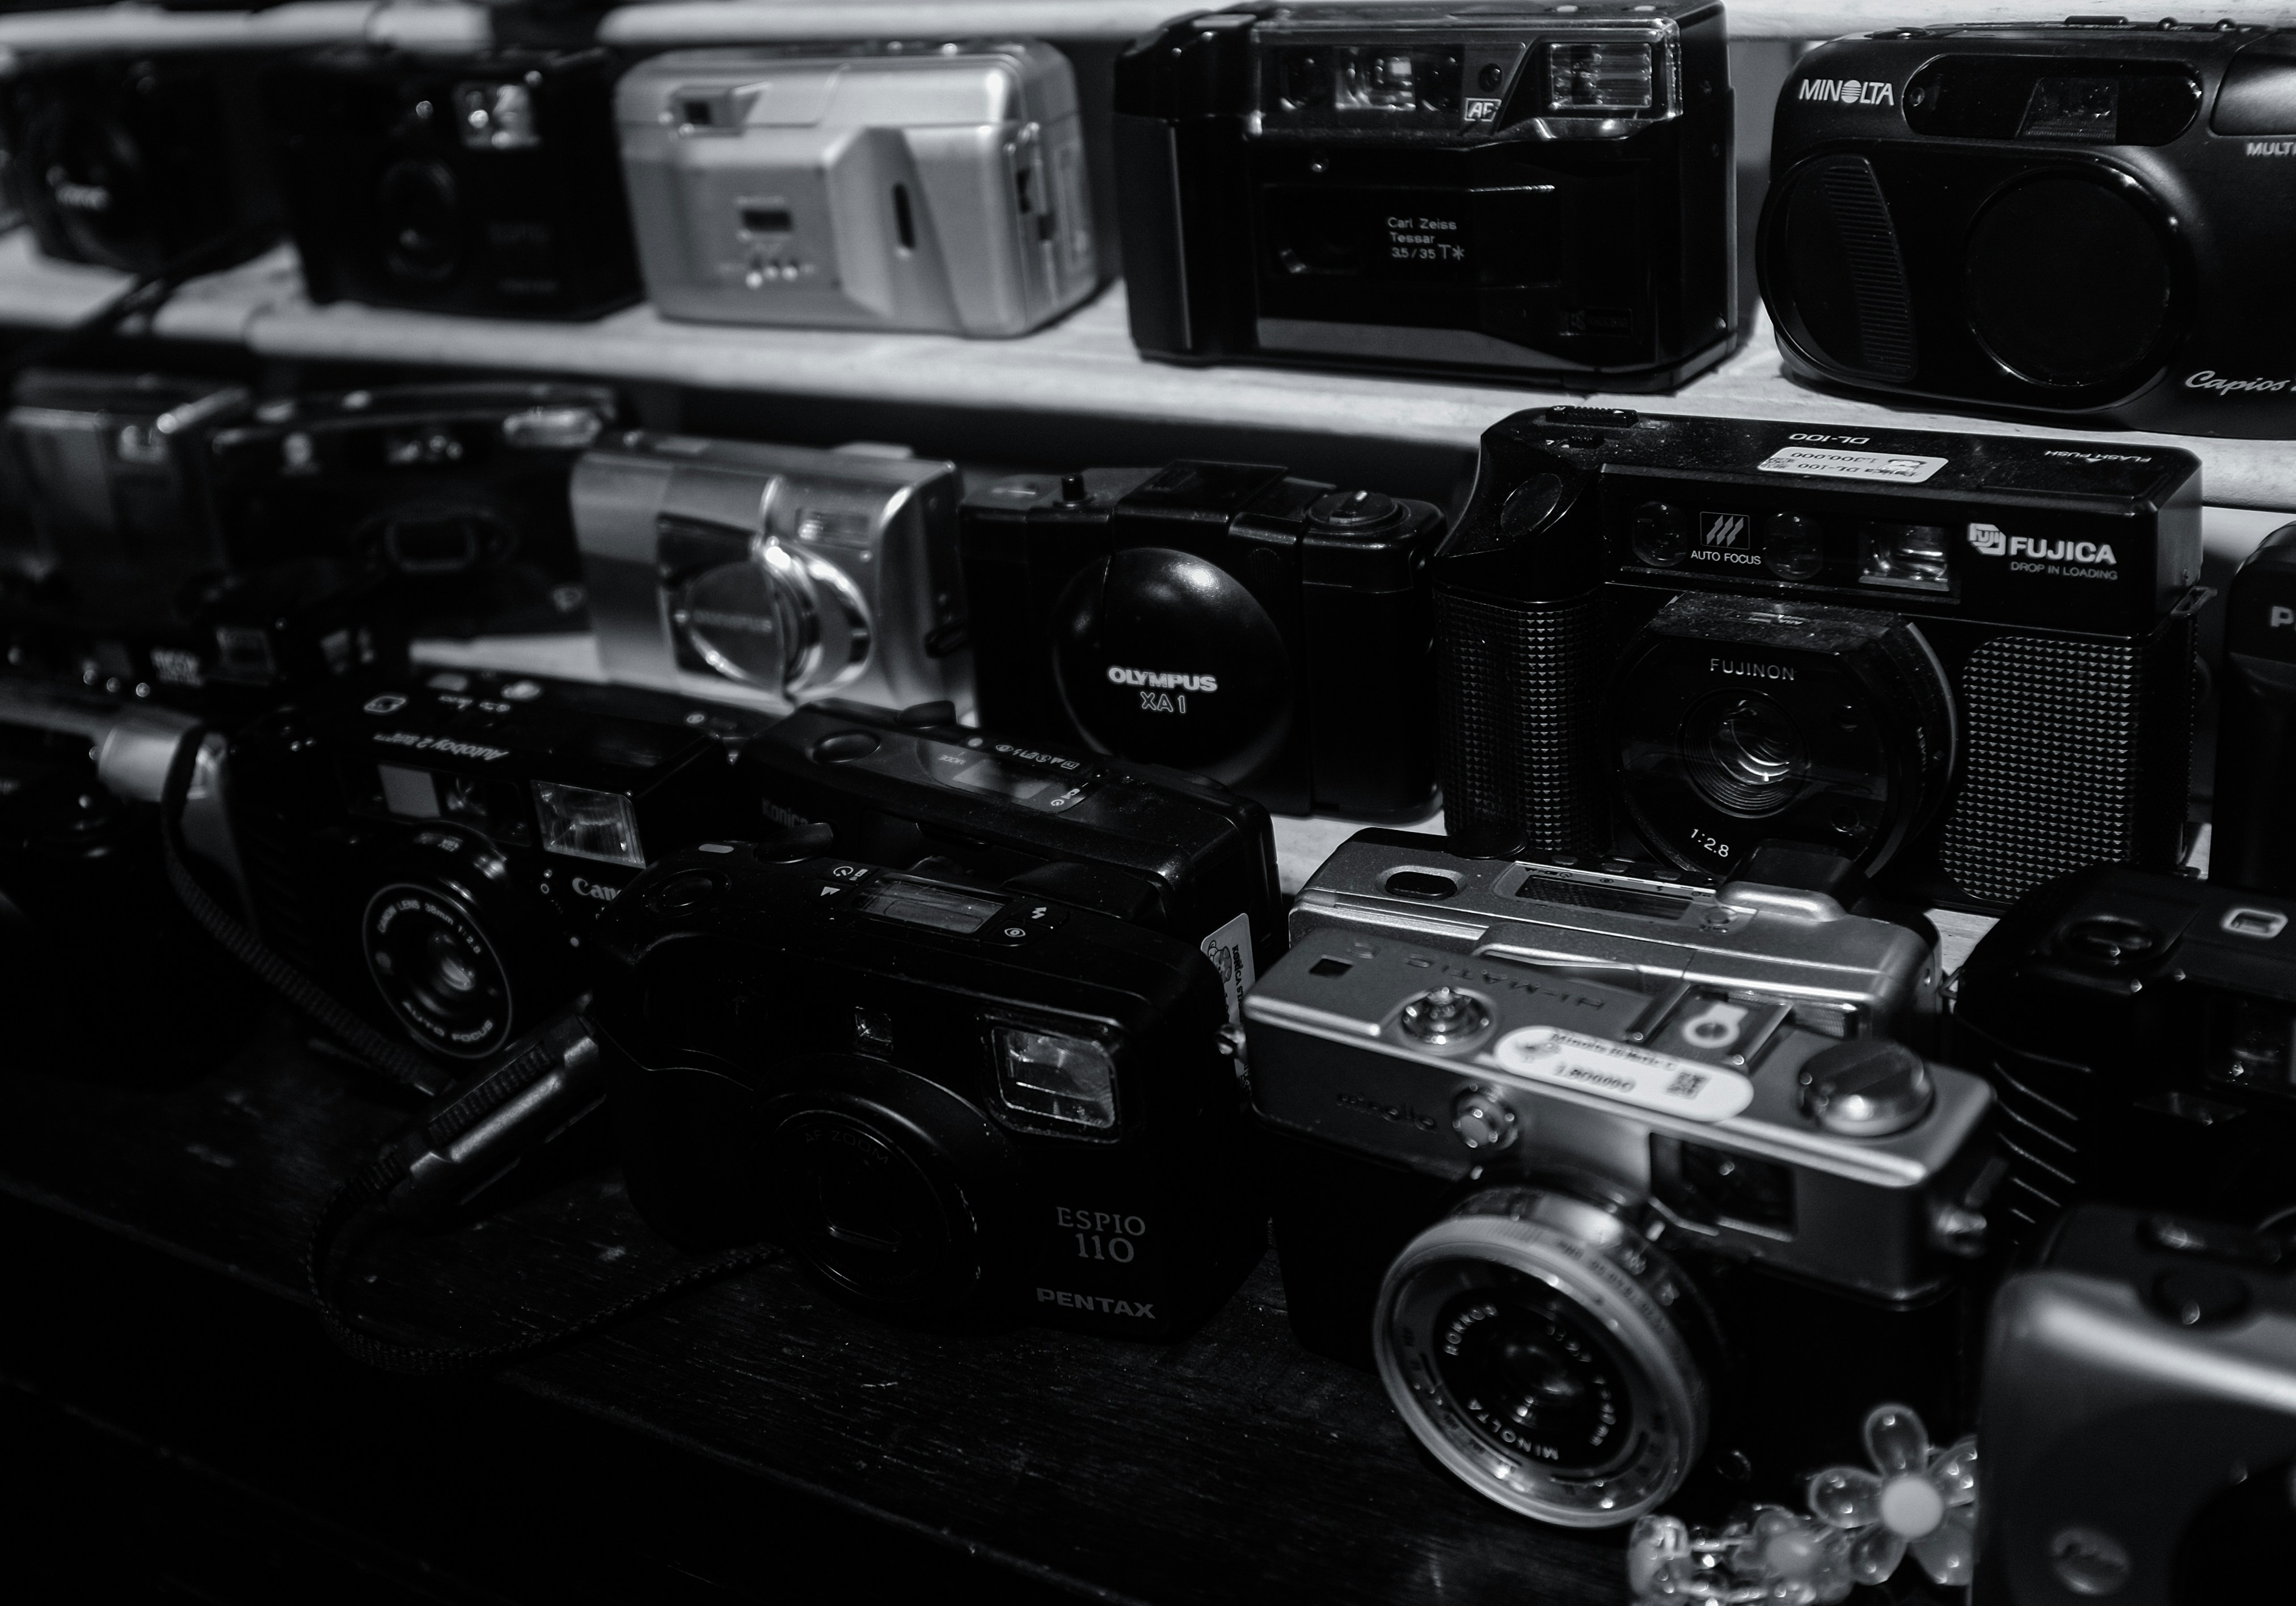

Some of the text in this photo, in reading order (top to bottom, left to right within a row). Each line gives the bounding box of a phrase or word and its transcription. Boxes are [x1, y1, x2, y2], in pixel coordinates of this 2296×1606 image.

[1799, 79, 1895, 107] MINOLTA
[1467, 102, 1495, 119] AF
[1387, 217, 1458, 230] Carl Zeiss
[1389, 231, 1436, 244] Tessar
[2185, 370, 2291, 396] Capios
[1788, 433, 1871, 445] DL-100
[2043, 450, 2152, 463] FLASH PUSH
[1797, 463, 1862, 475] DL-100
[1690, 549, 1762, 566] AUTO FOCUS
[2008, 536, 2117, 566] FUJICA
[2010, 561, 2118, 581] DROP IN LOADING
[2270, 605, 2296, 628] P
[1107, 665, 1218, 694] OLYMPUS
[1709, 658, 1797, 681] FUJINON
[429, 738, 510, 762] Autoboy
[938, 754, 966, 765] MODE
[1689, 827, 1730, 859] 1:2.8
[572, 877, 622, 901] Can
[424, 903, 454, 925] 38mm
[450, 1018, 495, 1042] FOCUS
[1336, 1092, 1437, 1134] minolta
[805, 1129, 889, 1165] AF ZOOM
[1056, 1206, 1146, 1237] ESPIO
[1075, 1232, 1136, 1264] 110
[1036, 1286, 1157, 1319] PENTAX
[1466, 1396, 1559, 1461] MINOLTA
